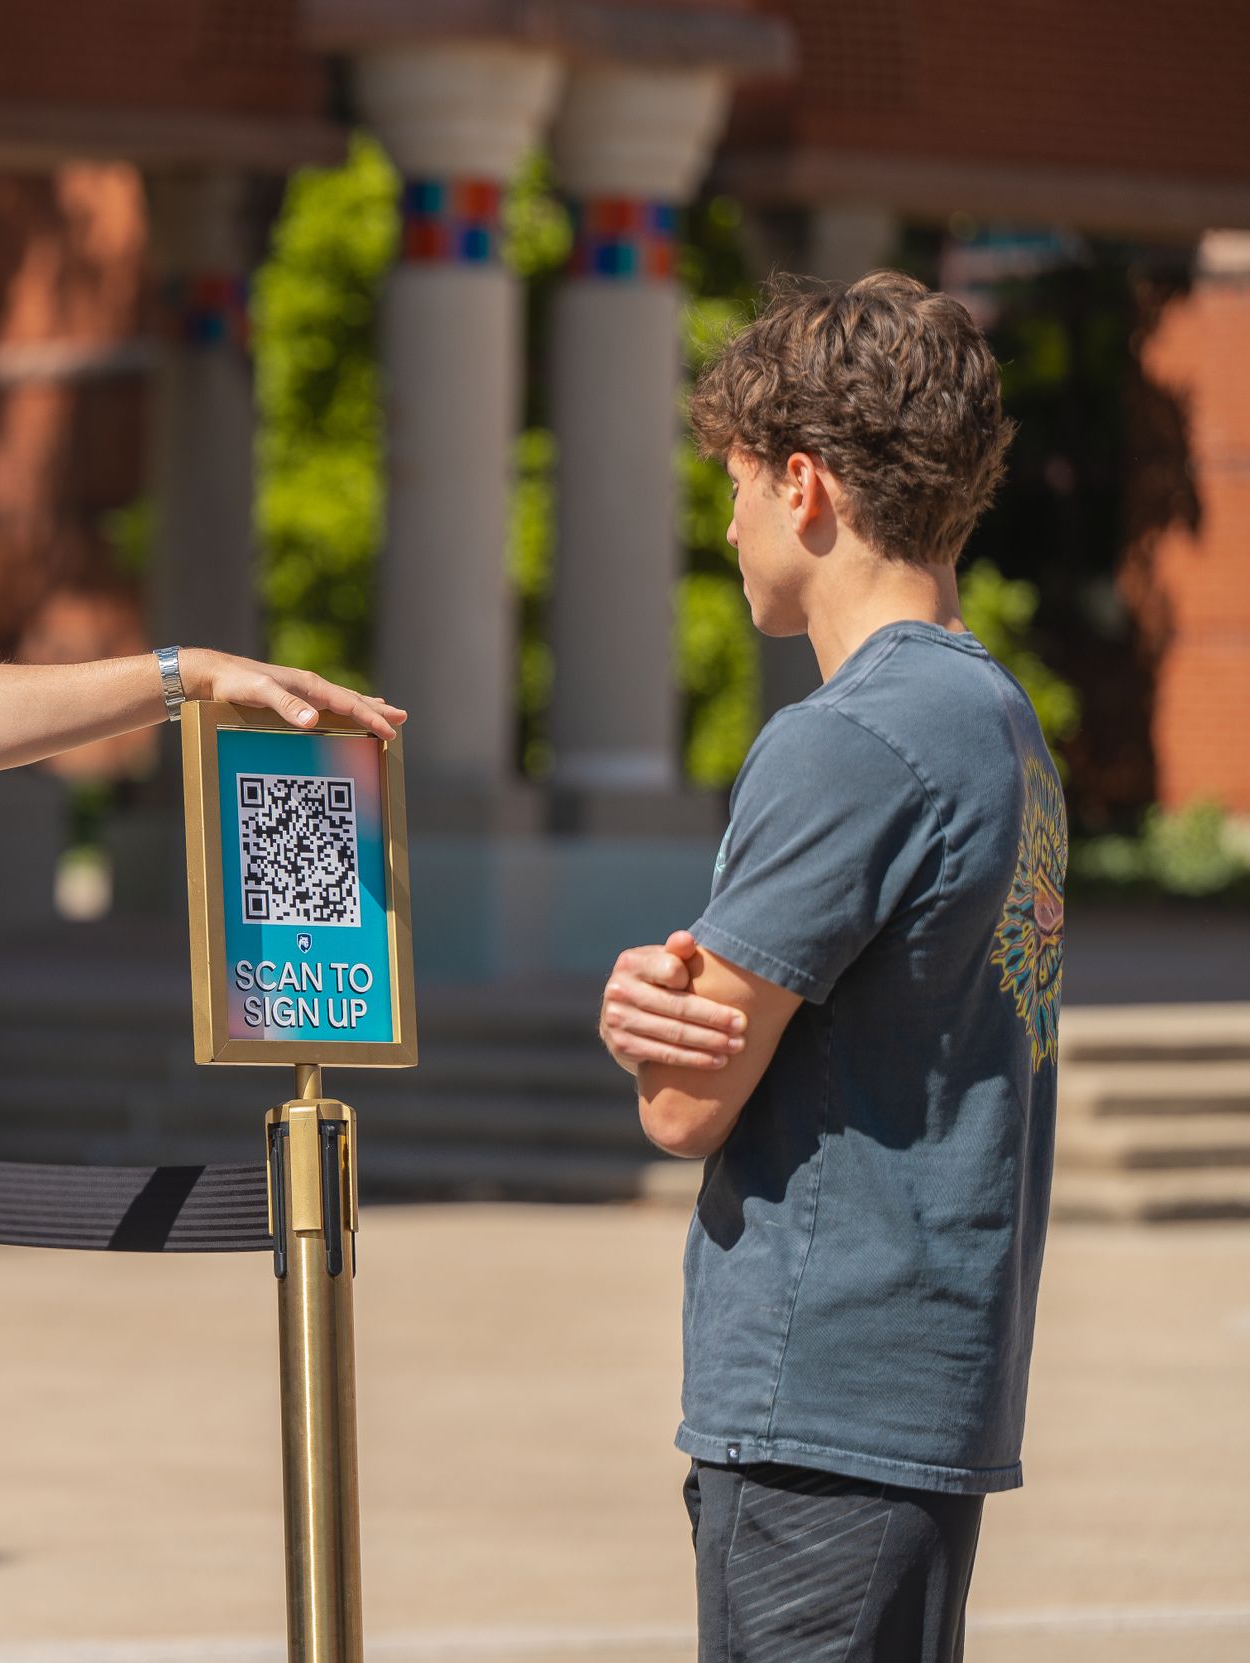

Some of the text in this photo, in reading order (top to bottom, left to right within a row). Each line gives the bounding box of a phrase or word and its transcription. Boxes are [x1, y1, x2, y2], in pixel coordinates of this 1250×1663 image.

[235, 960, 374, 994] SCAN TO
[244, 996, 368, 1029] SIGN UP
